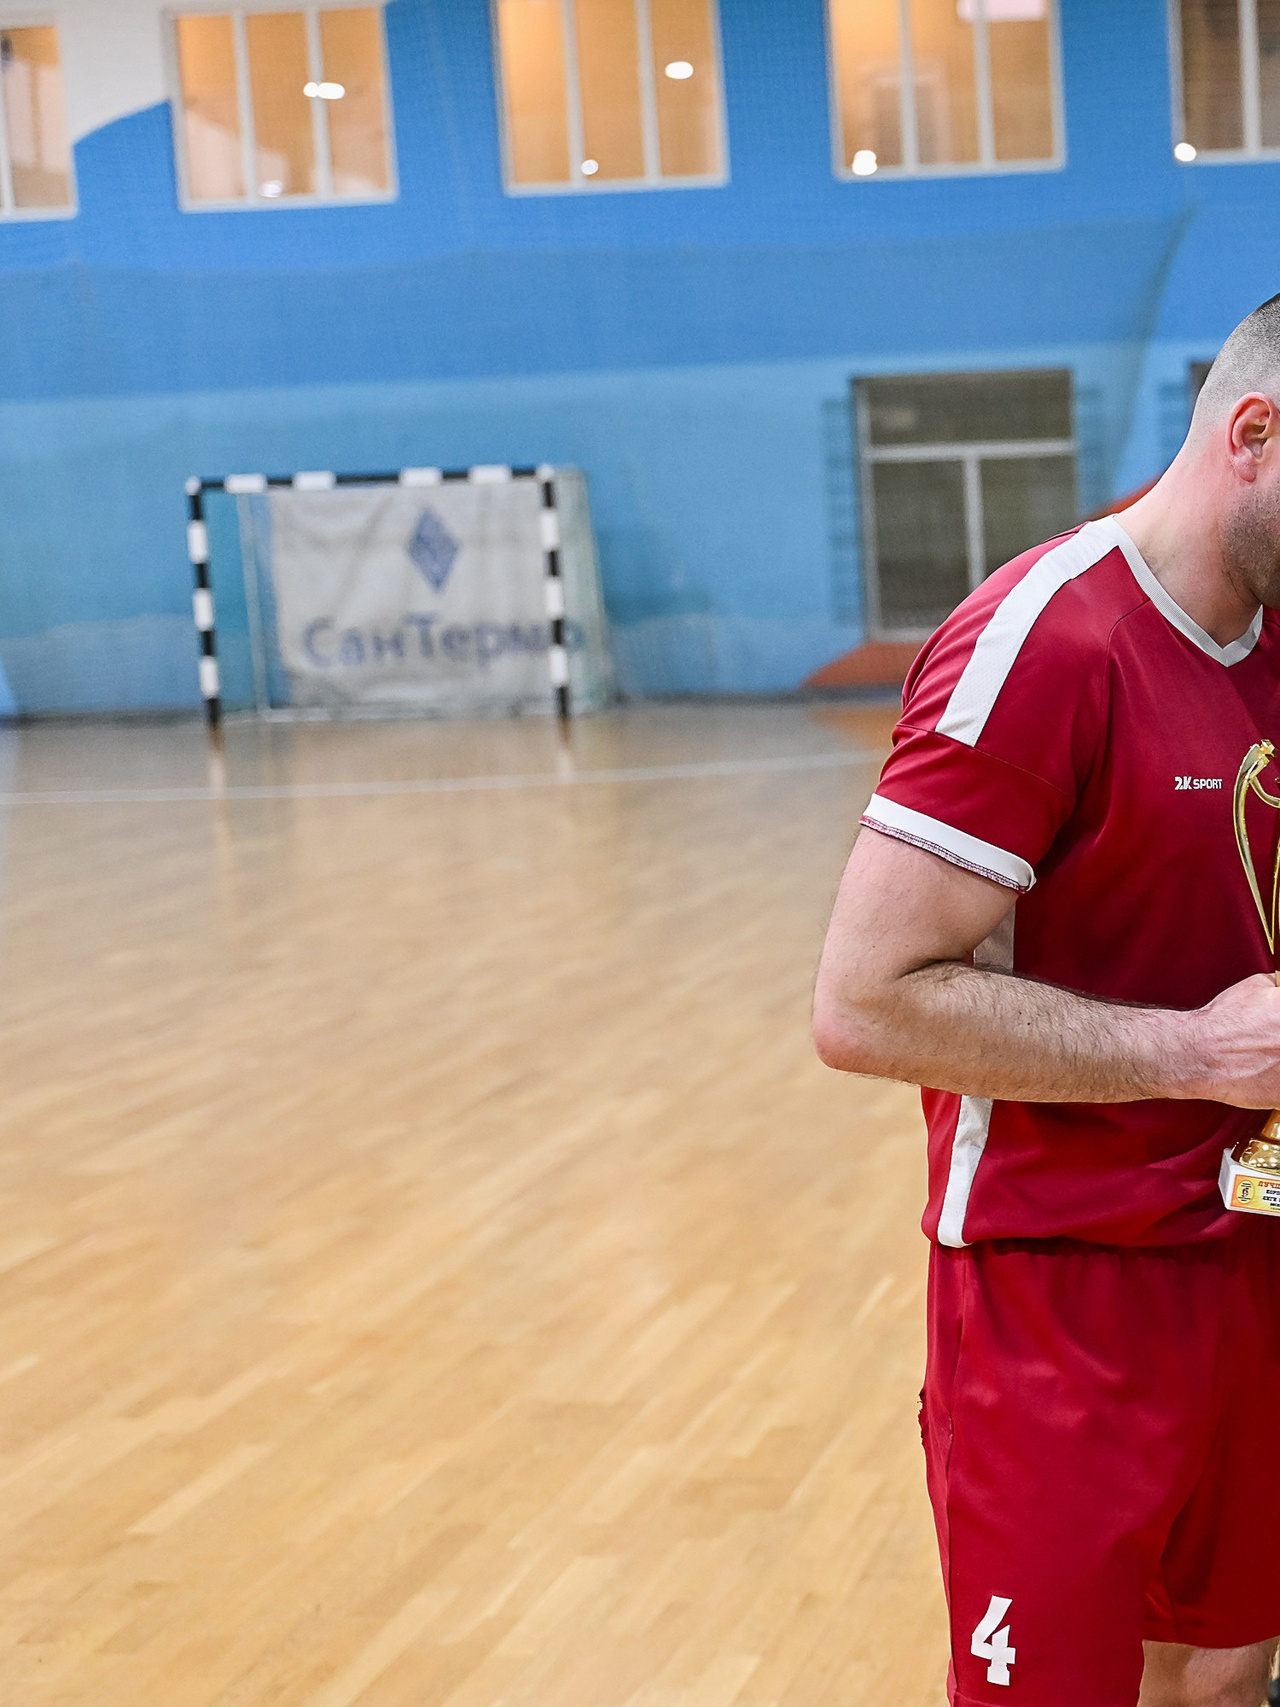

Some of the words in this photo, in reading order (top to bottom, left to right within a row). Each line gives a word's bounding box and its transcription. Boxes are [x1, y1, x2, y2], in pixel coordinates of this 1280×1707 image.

[1174, 776, 1192, 790] 2K
[1193, 778, 1222, 789] SPORT
[970, 1595, 1016, 1686] 4
